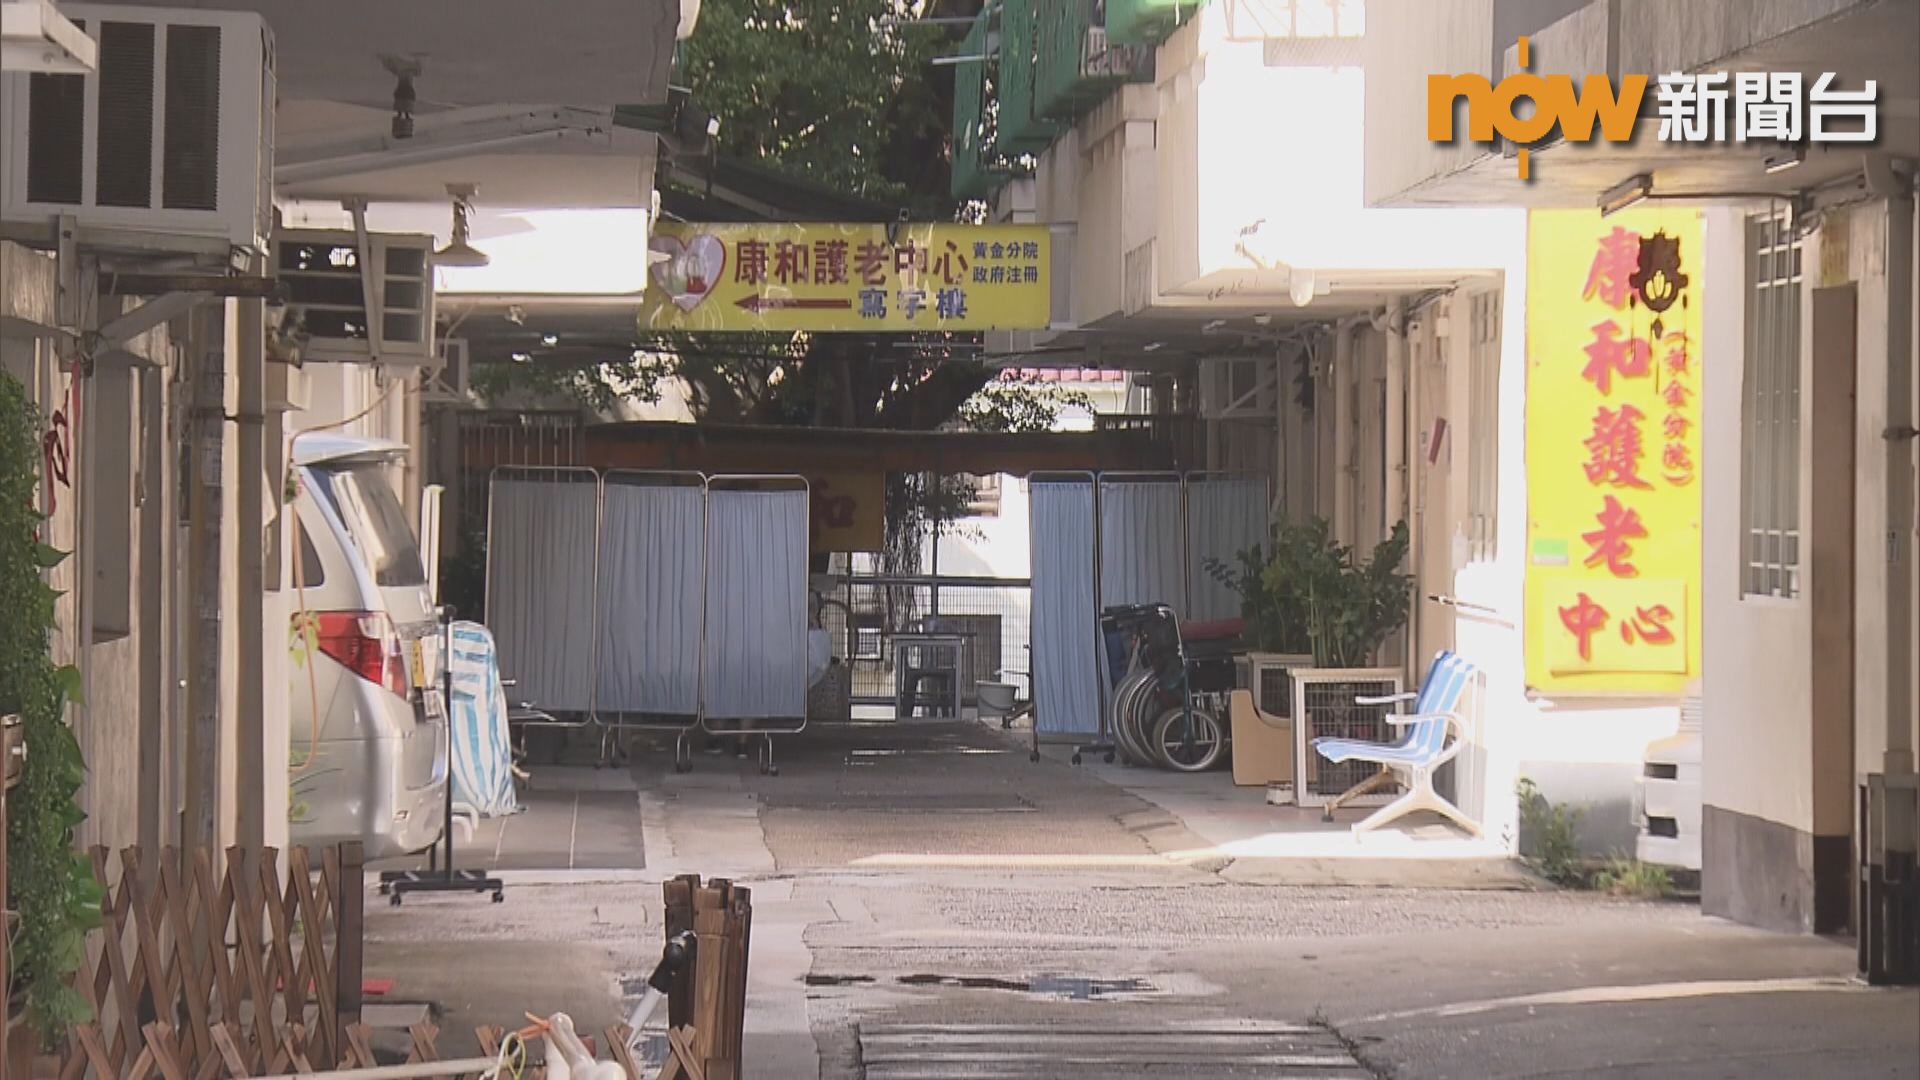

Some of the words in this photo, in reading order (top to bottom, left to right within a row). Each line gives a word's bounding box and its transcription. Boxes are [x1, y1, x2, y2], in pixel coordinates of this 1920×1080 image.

[734, 239, 969, 286] 康和護老中心
[857, 288, 968, 320] 寫字樓
